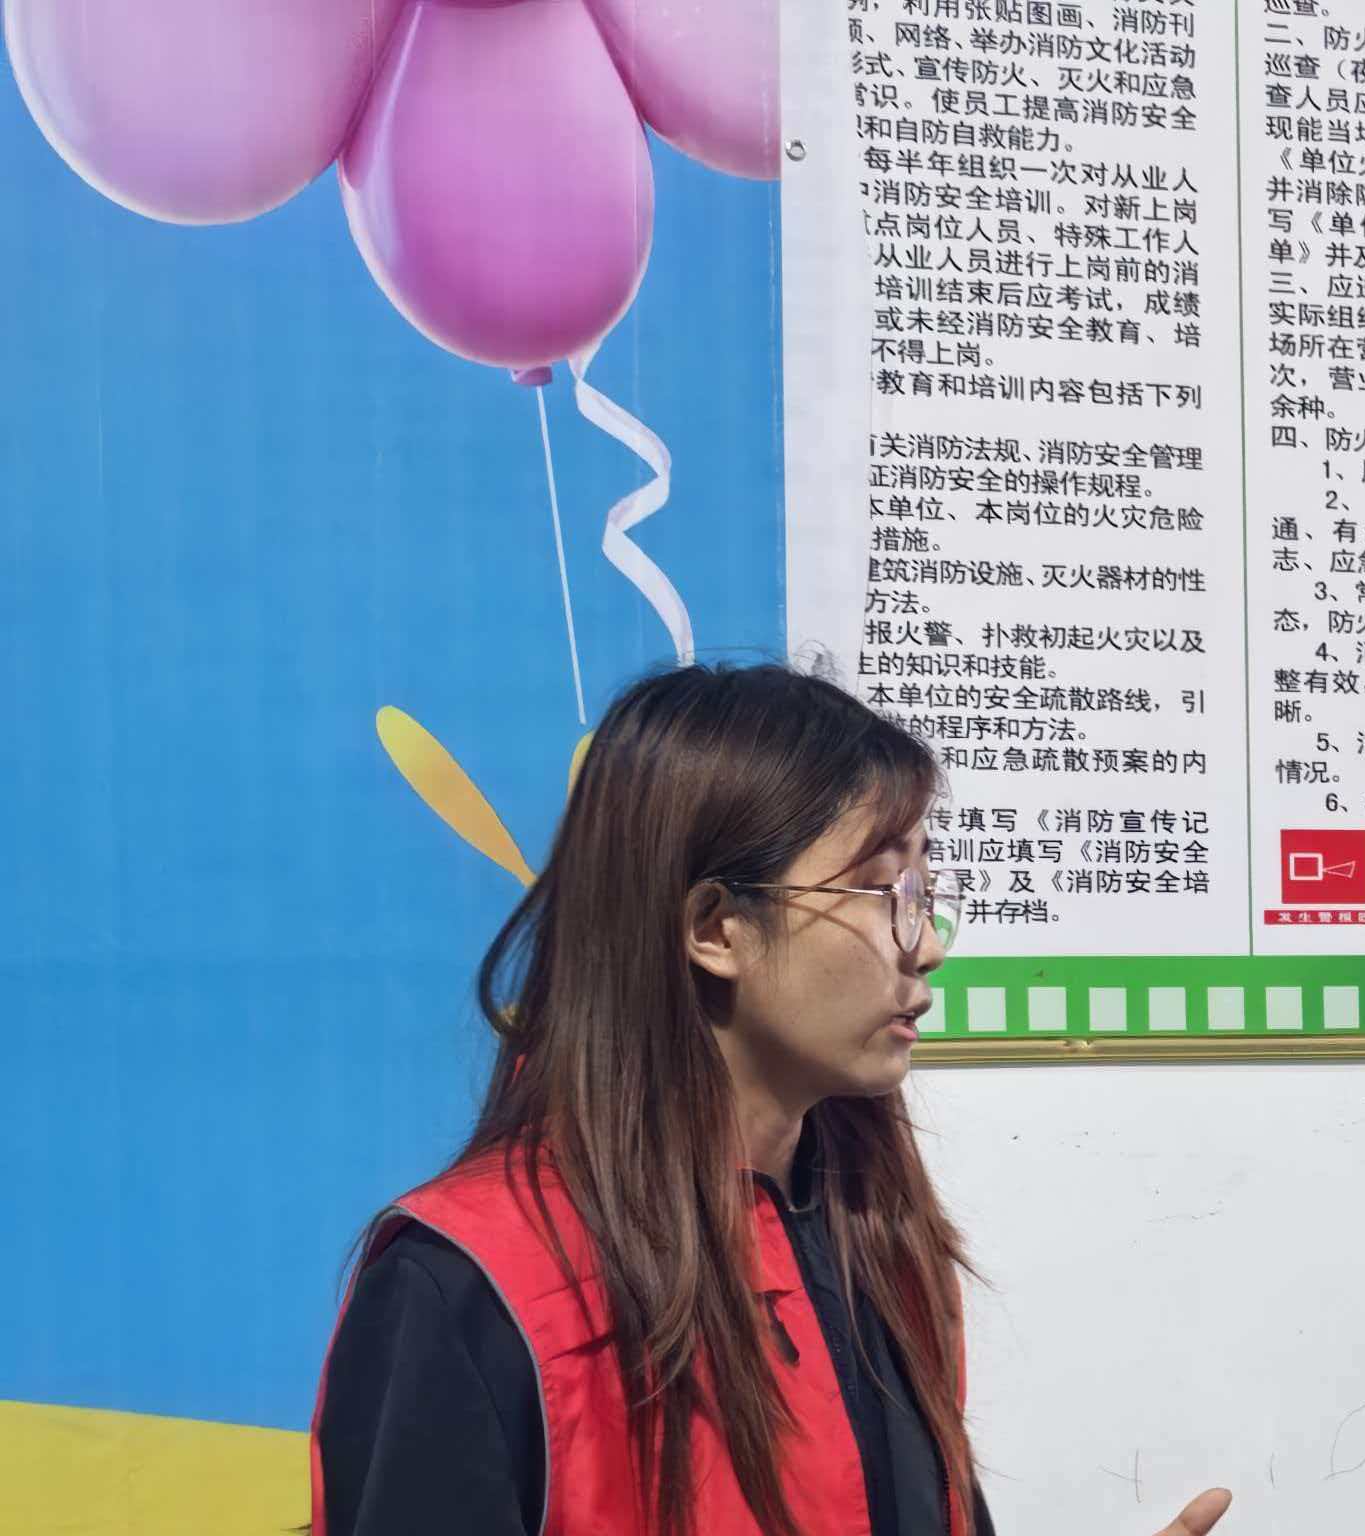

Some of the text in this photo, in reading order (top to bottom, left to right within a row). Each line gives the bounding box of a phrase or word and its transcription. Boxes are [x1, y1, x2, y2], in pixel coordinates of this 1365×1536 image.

[873, 244, 1200, 287] 从业人员进行上岗前的消
[875, 306, 1202, 348] 或未经消防安全教育、培
[871, 339, 995, 368] 不得上岗。
[871, 526, 941, 553] 措施。
[865, 588, 931, 615] 方法。
[866, 619, 1206, 654] 报火警、扑救初起火灾以及
[867, 683, 1205, 715] 本单位的安全疏散路线，引
[1274, 699, 1314, 724] 晰。
[1275, 759, 1343, 785] 情况。
[965, 898, 1060, 924] 并存档。
